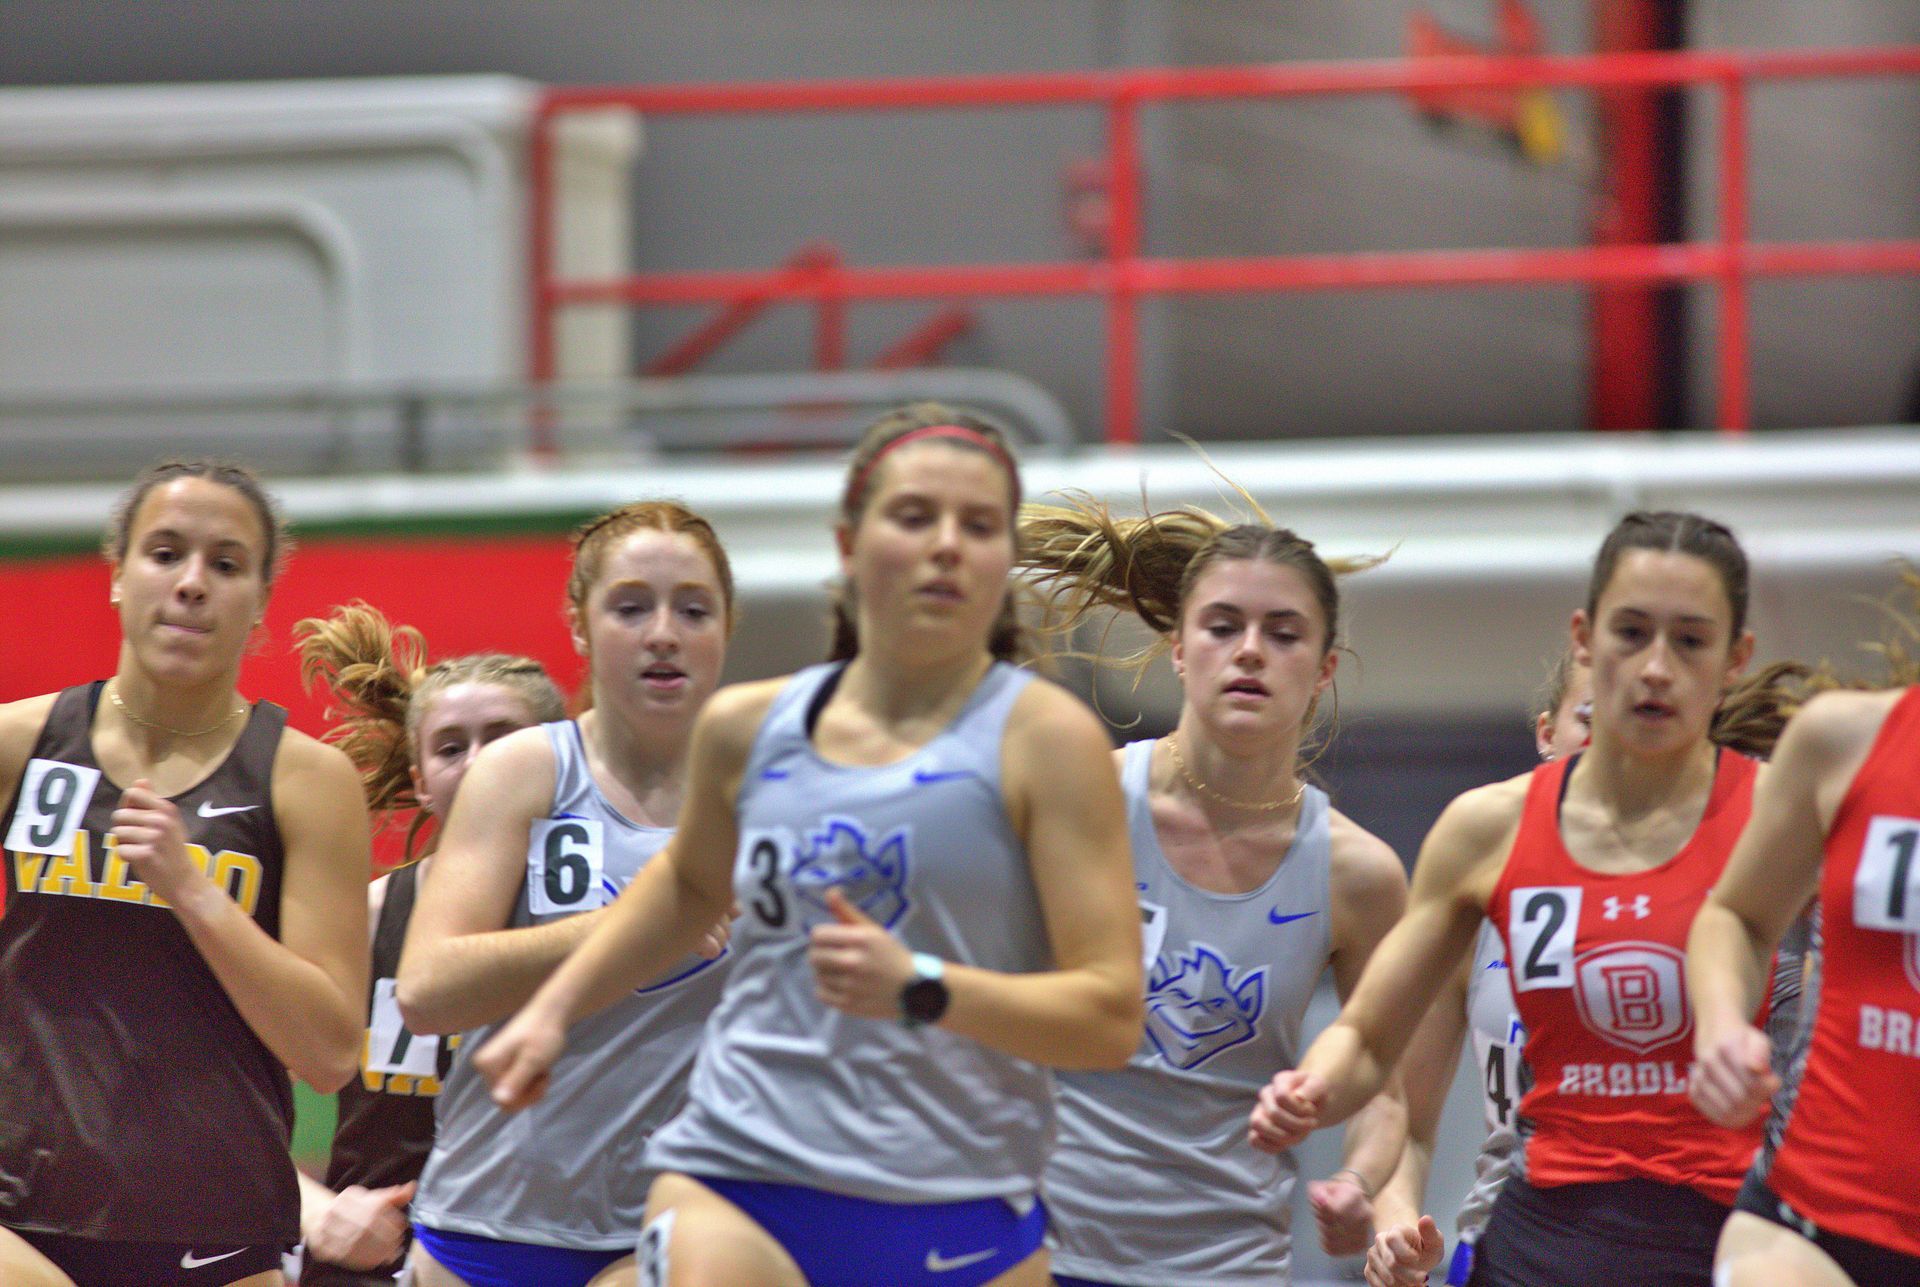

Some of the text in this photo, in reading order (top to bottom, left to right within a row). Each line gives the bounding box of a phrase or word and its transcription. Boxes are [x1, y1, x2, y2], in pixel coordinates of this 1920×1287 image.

[30, 766, 78, 847] 9
[545, 823, 590, 905] 6
[750, 838, 787, 928] 3
[1887, 829, 1920, 920] 1
[1523, 891, 1567, 980] 2
[1602, 964, 1664, 1031] B
[1858, 1004, 1920, 1058] BR
[1487, 1043, 1512, 1126] 4
[1559, 1061, 1697, 1097] BRADL
